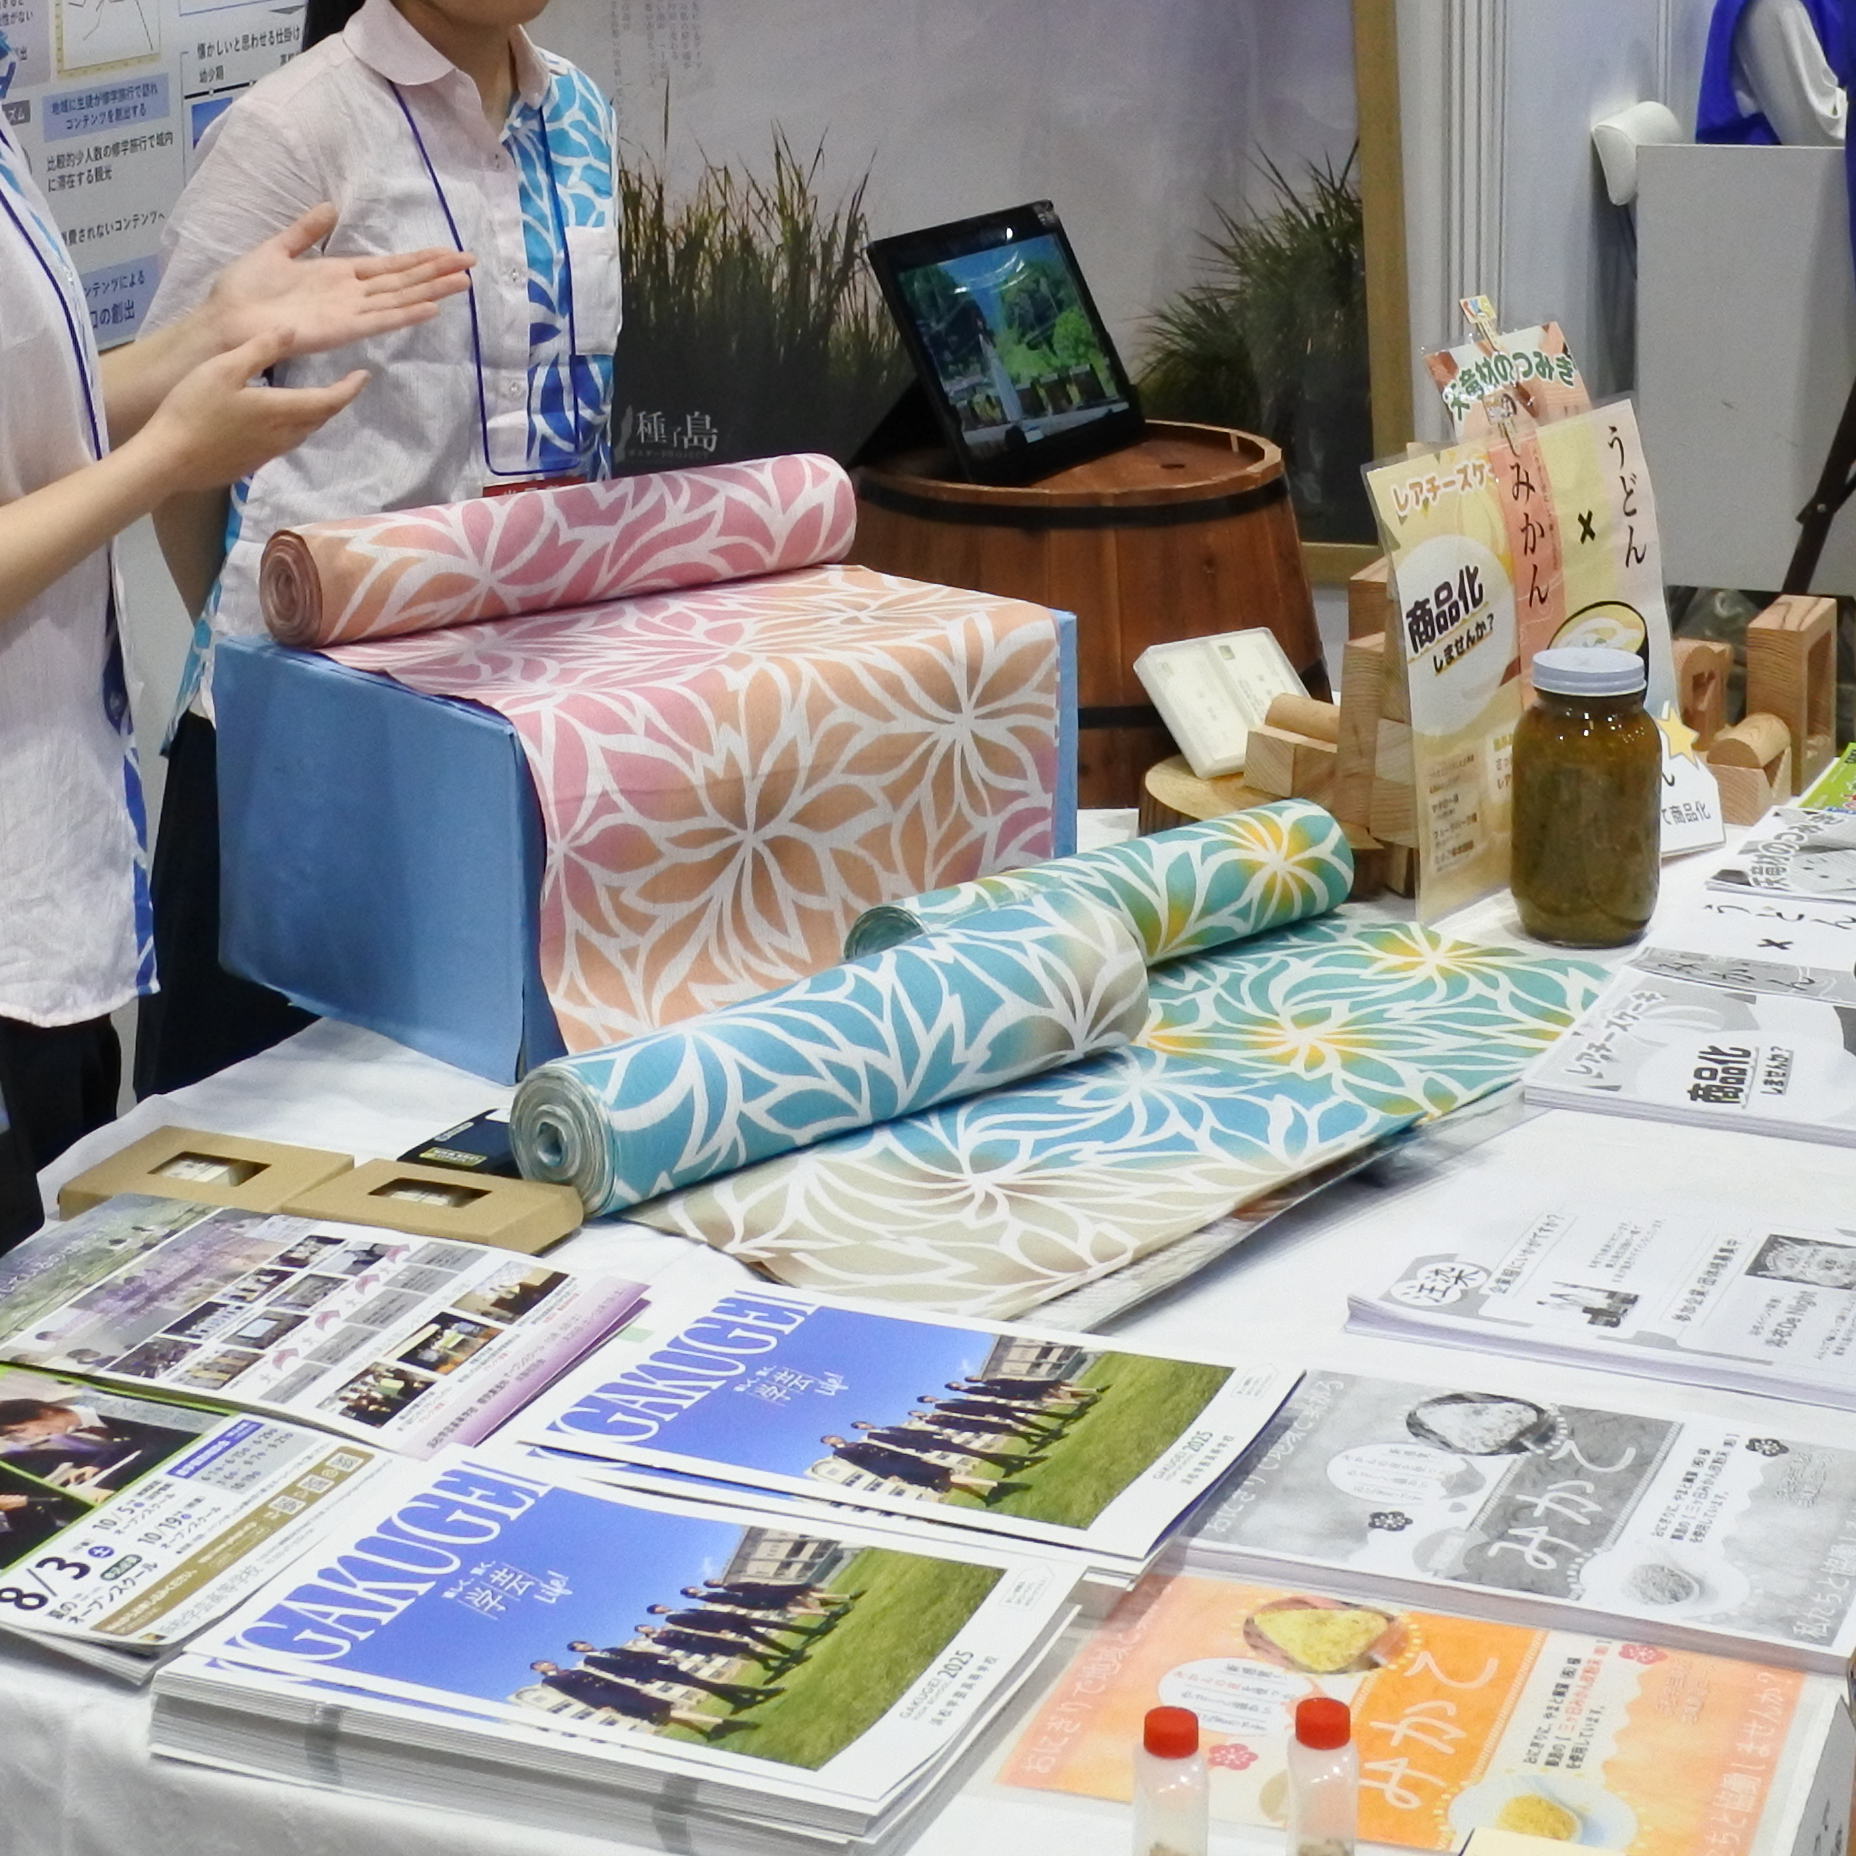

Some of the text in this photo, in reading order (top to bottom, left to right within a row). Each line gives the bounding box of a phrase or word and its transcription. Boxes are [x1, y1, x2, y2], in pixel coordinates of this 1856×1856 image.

[1406, 565, 1484, 653] 商品化
[1688, 1045, 1752, 1104] 商品化
[1183, 1428, 1215, 1454] 2025
